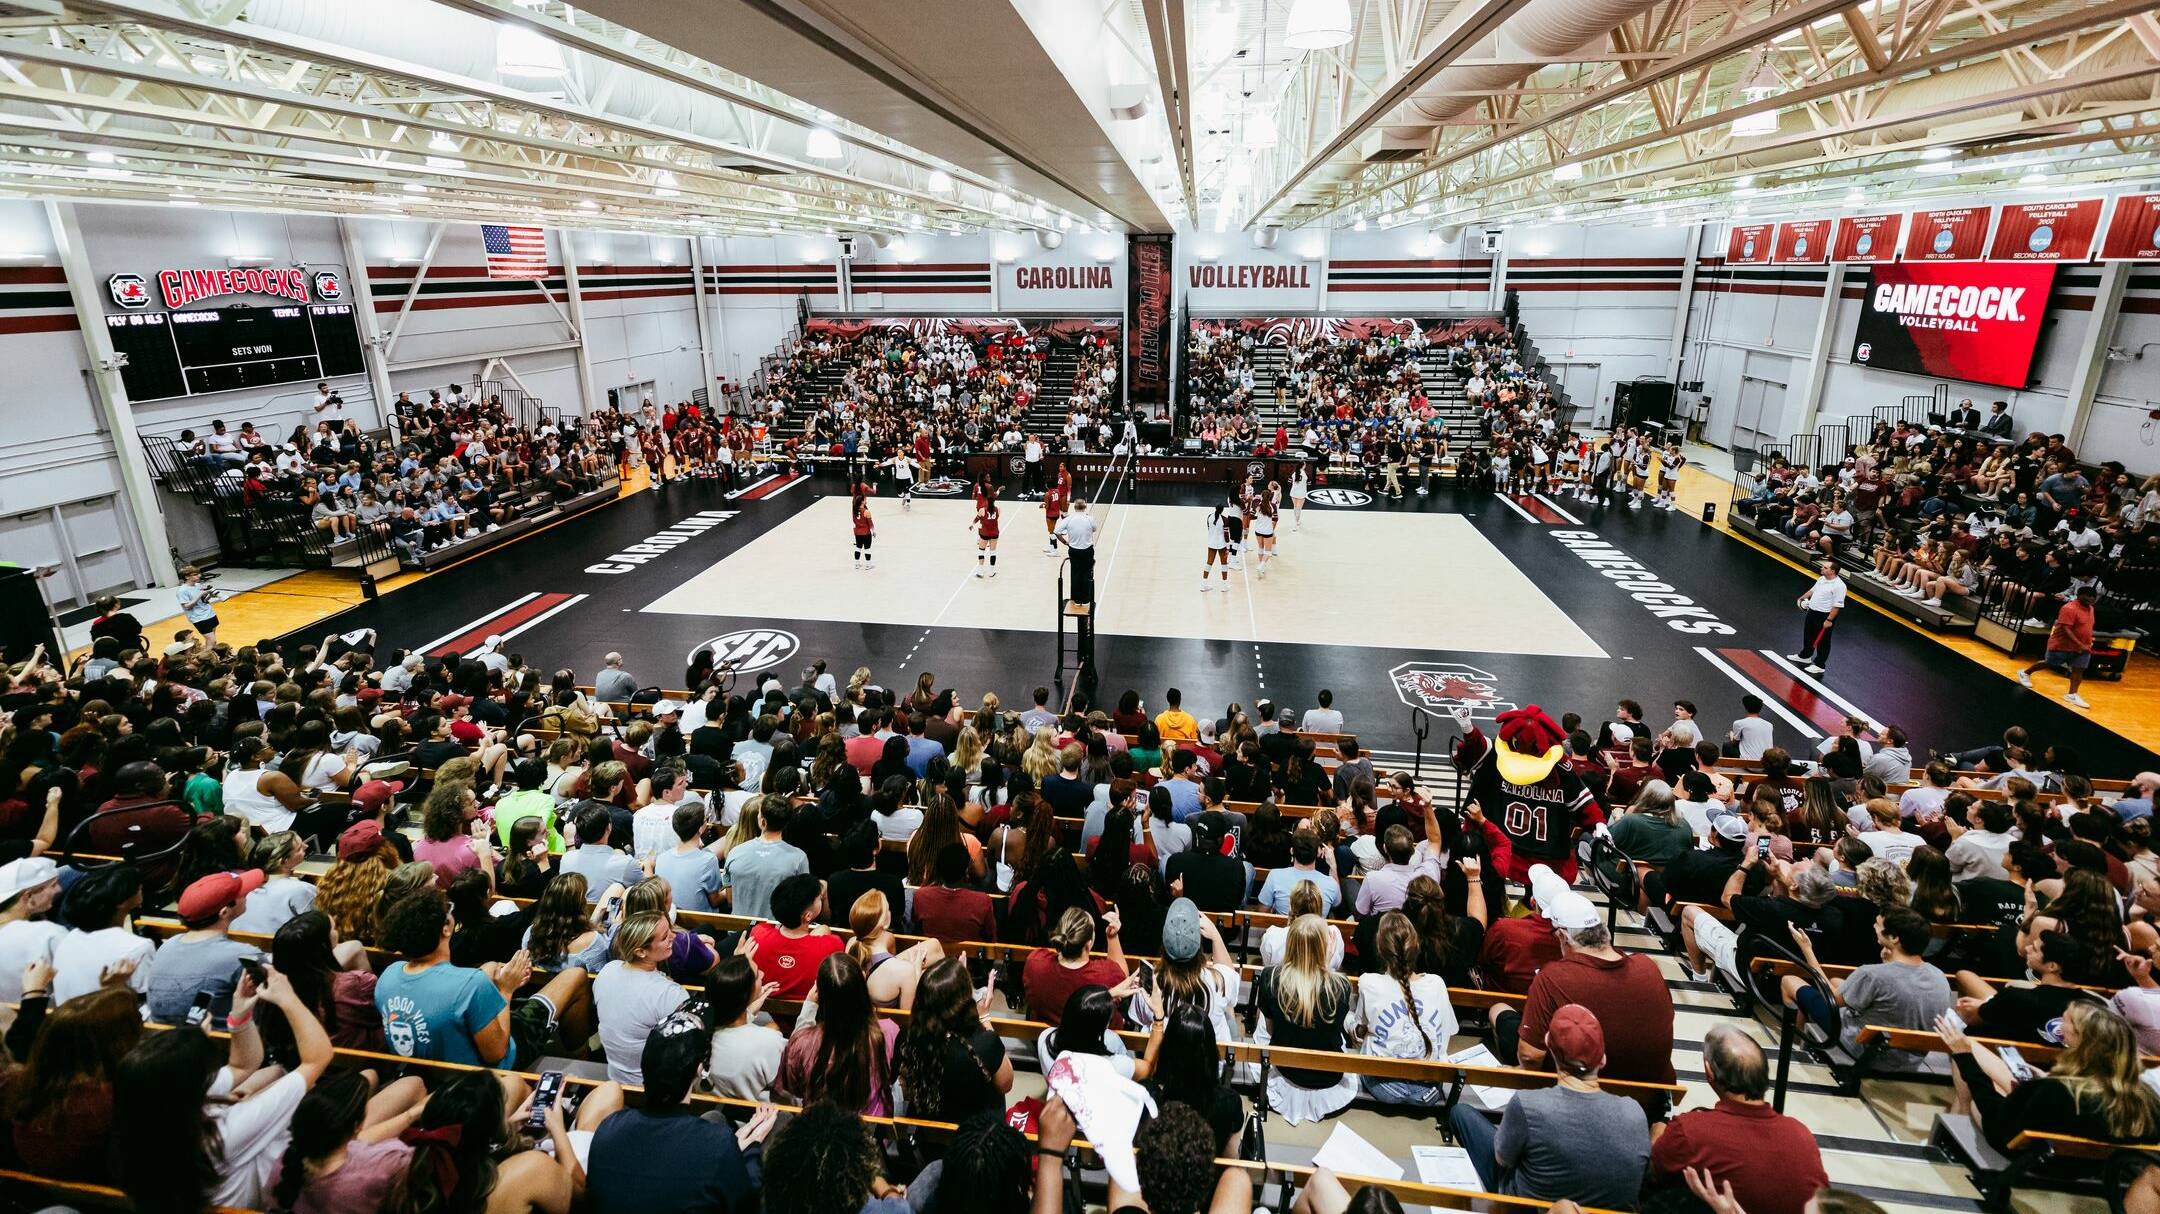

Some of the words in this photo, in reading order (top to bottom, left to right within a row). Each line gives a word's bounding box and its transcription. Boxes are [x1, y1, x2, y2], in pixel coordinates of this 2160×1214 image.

[2045, 202, 2078, 210] CAROLINA
[159, 269, 309, 309] GAMECOCKS
[1016, 266, 1113, 289] CAROLINA
[1189, 265, 1311, 289] VOLLEYBALL
[1140, 285, 1160, 308] TO
[1873, 283, 2026, 322] GAMECOCK.
[172, 312, 219, 323] GAMECOCKS
[272, 308, 300, 318] TEMPLE
[1899, 315, 1979, 332] VOLLEYBALL
[232, 346, 252, 355] SETS
[253, 344, 273, 354] WON
[1139, 309, 1160, 382] FOREVER
[1135, 466, 1197, 474] VOLLEYBALL
[1309, 490, 1367, 505] SEC
[584, 510, 742, 574] CAROLINA
[1549, 529, 1737, 635] GAMECOCKS
[710, 632, 791, 670] SEC
[1504, 801, 1547, 841] 01
[387, 996, 415, 1014] GOOD
[413, 1009, 431, 1045] VIBES
